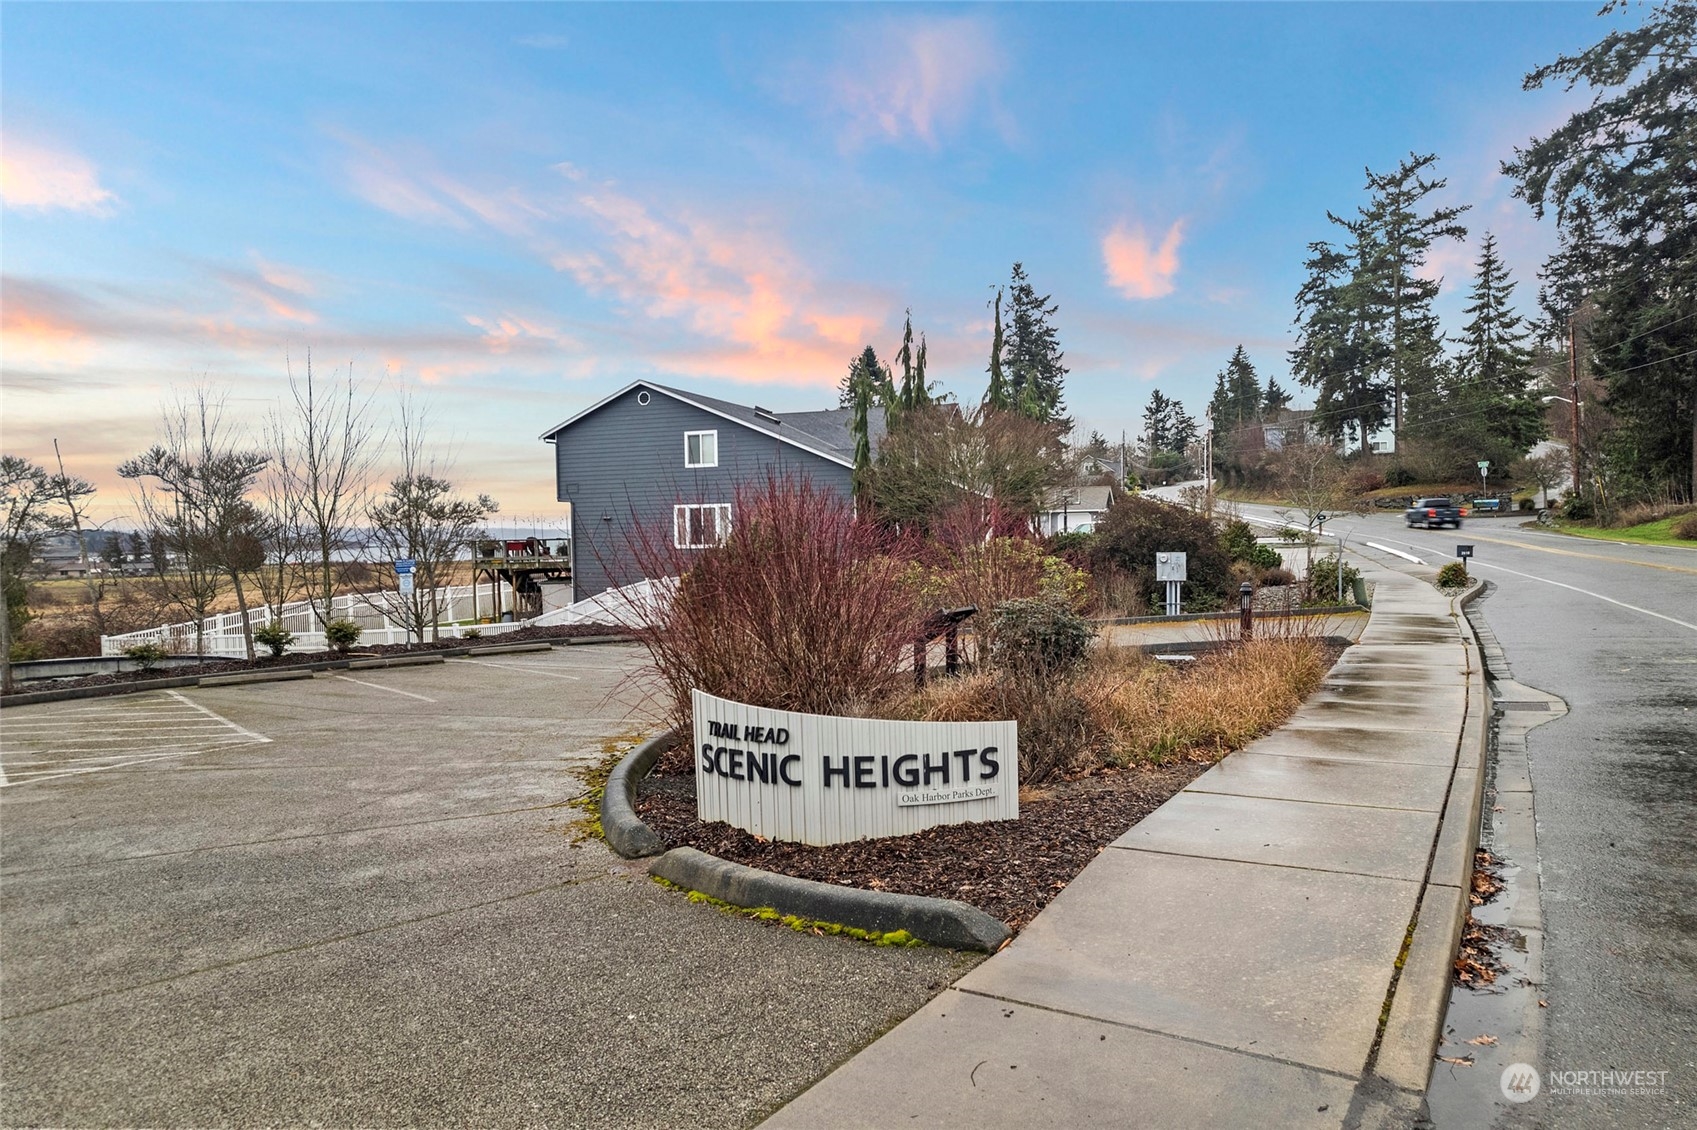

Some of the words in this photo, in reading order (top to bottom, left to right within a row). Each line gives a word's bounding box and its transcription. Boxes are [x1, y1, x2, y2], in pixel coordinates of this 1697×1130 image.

[708, 720, 741, 741] TRAIL
[744, 725, 790, 745] HEAD
[702, 743, 802, 787] SCENIC
[823, 746, 1000, 788] HEIGHTS
[902, 794, 919, 803] Oak
[922, 792, 950, 802] Harbor
[952, 790, 974, 799] Parks
[975, 787, 995, 797] Dept.
